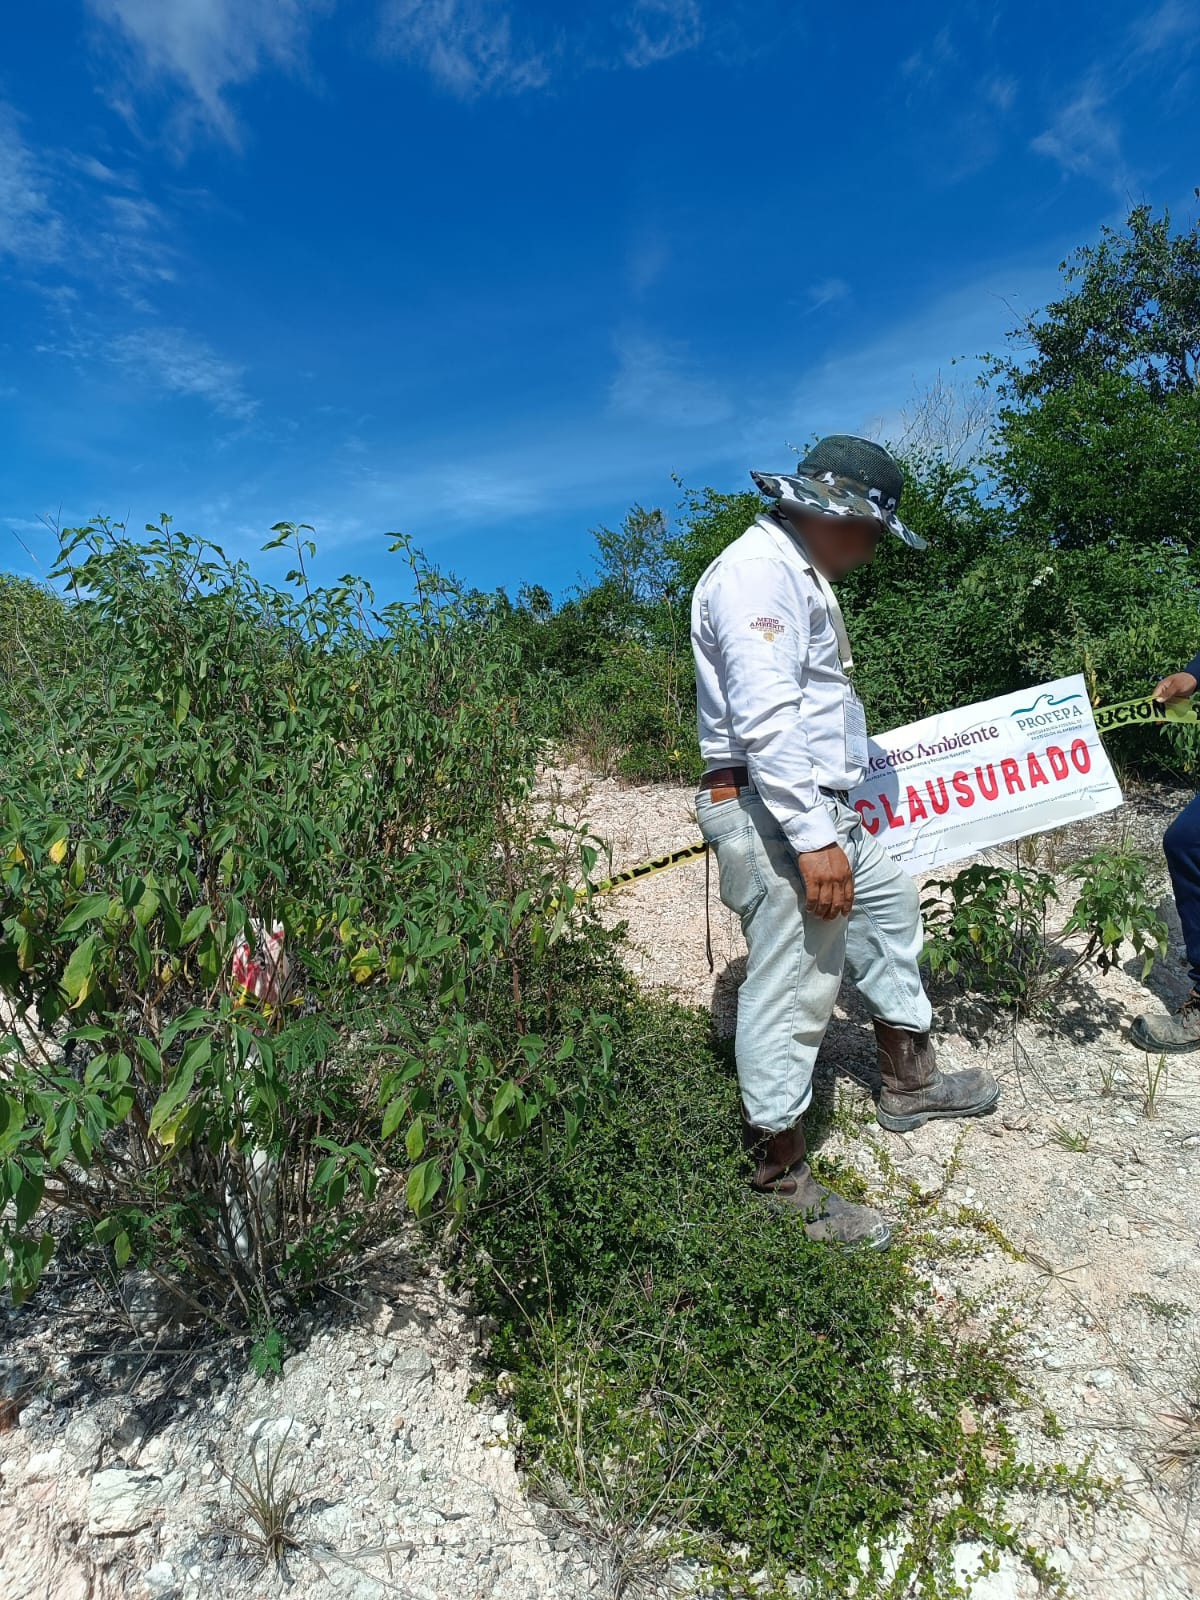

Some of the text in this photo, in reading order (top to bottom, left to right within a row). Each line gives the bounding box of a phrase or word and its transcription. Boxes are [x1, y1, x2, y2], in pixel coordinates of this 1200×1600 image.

[749, 622, 785, 631] AMBIENTE
[757, 617, 779, 625] MEDIO
[1016, 705, 1083, 731] PROFEPA
[918, 724, 1000, 759] Ambiente
[854, 738, 1092, 835] CLAUSURADO
